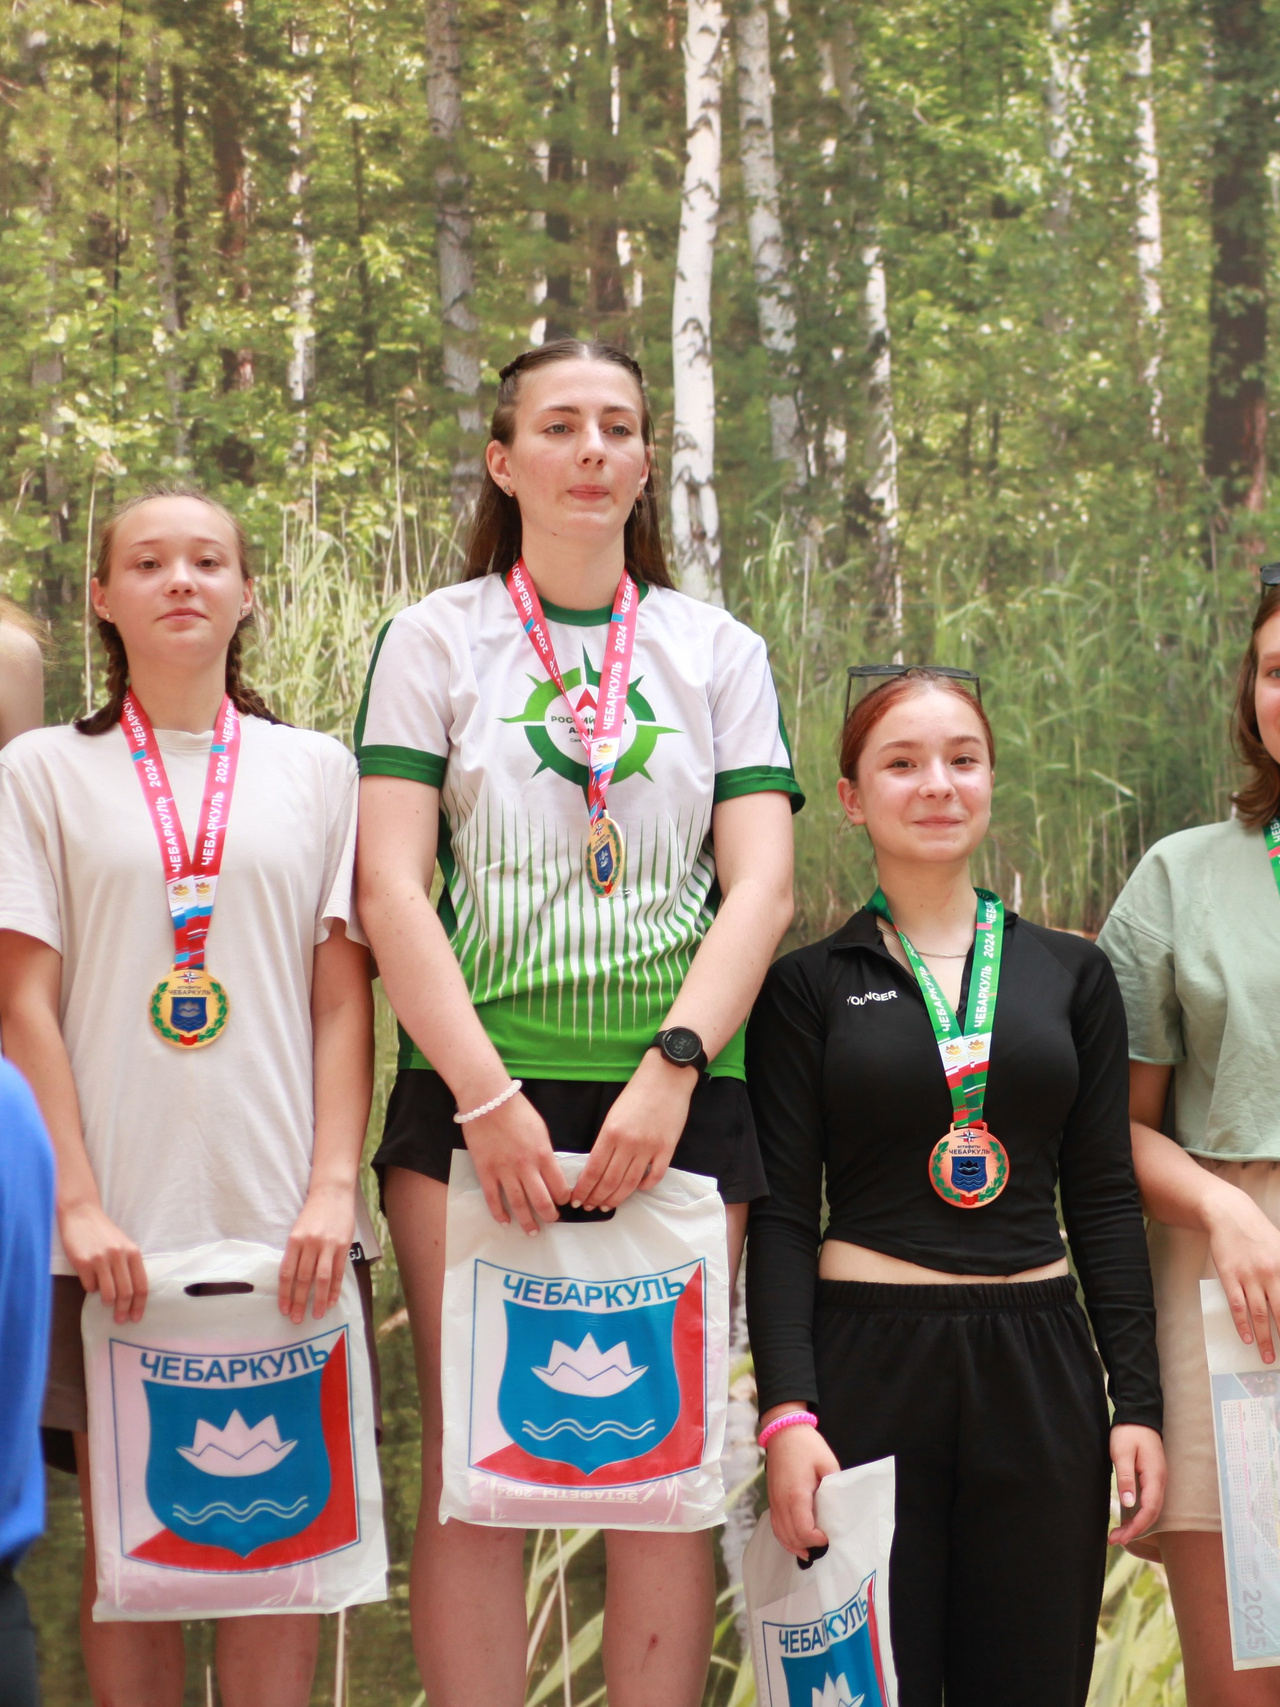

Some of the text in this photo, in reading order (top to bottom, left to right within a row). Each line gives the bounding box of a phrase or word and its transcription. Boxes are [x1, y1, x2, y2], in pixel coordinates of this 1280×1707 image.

[533, 624, 549, 654] 2024
[602, 661, 623, 730] ЧЕБАРКУЛЬ
[615, 625, 627, 654] 2024
[143, 759, 161, 787] 2024
[155, 796, 182, 873] ЧЕБАРКУЛЬ
[201, 792, 224, 866] ЧЕБАРКУЛЬ
[215, 755, 230, 783] 2024
[919, 965, 951, 1032] ЧЕБАРКУЛЬ
[974, 965, 992, 1028] ЧЕБАРКУЛЬ
[983, 933, 996, 958] 2024
[503, 1274, 686, 1309] ЧЕБАРКУЛЬ
[139, 1344, 330, 1383] ЧЕБАРКУЛЬ
[541, 1489, 639, 1501] ЭСТАФЕТЫ
[1242, 1589, 1267, 1651] 2025
